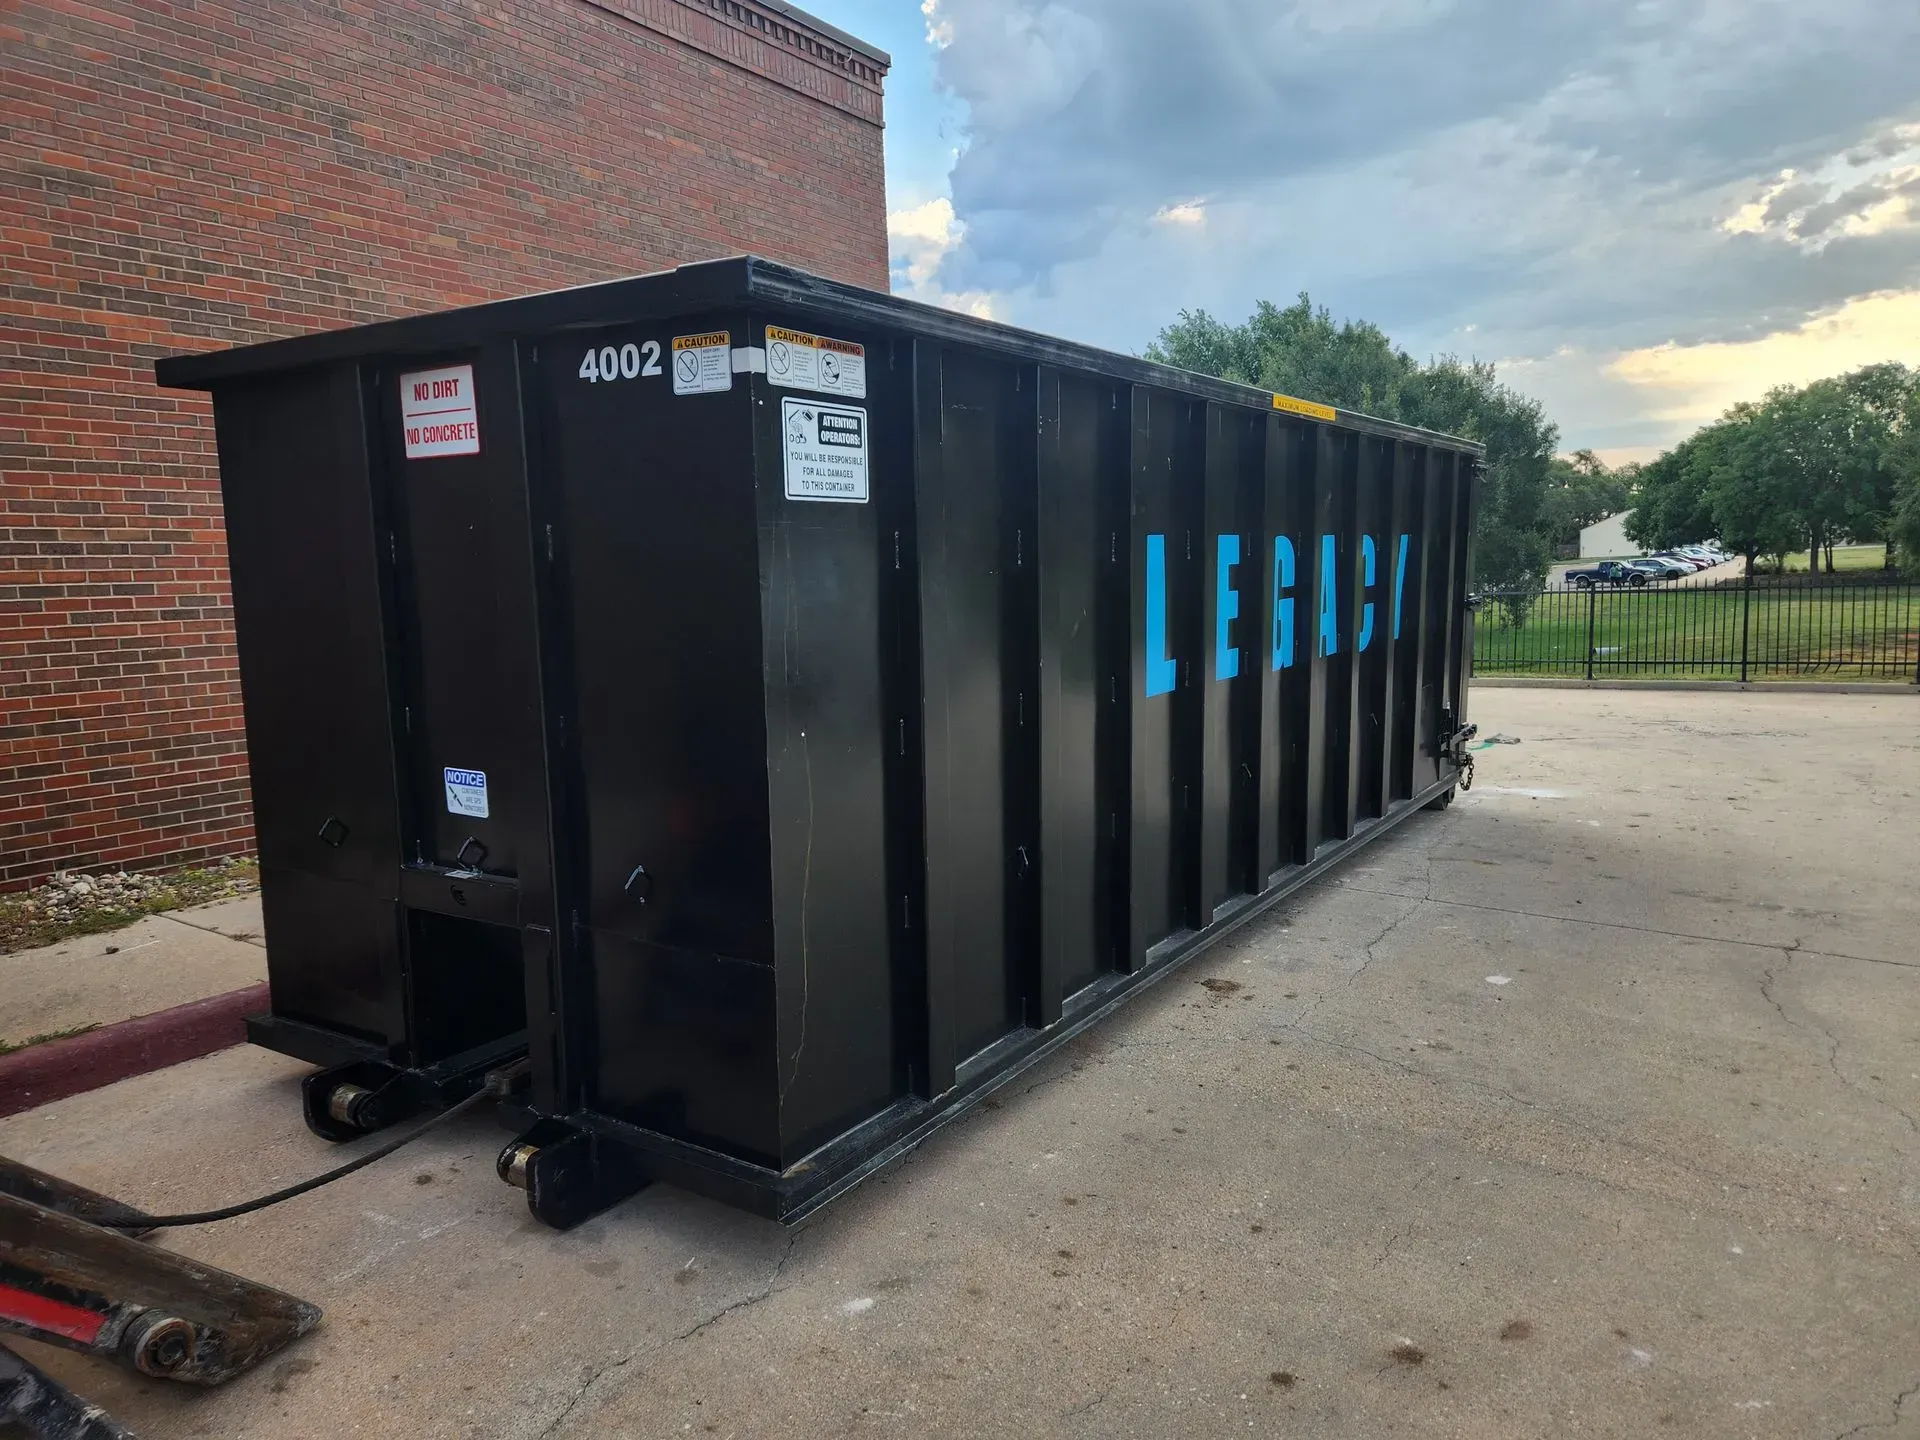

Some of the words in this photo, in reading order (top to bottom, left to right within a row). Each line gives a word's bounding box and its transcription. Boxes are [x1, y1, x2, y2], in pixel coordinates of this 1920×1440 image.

[684, 335, 725, 347] CAUTION
[777, 330, 813, 346] CAUTION
[825, 341, 860, 355] WARNING
[579, 340, 662, 383] 4002
[414, 383, 429, 401] NO
[433, 379, 459, 399] DIRT
[823, 415, 858, 430] ATTENTION
[406, 428, 420, 445] NO
[423, 422, 476, 443] CONCRETE
[820, 430, 860, 446] OPERATORS:
[790, 452, 803, 460] YOU
[804, 453, 817, 461] WILL
[819, 454, 826, 462] BE
[827, 454, 863, 466] RESPONSIBLE
[803, 466, 814, 476] FOR
[815, 467, 826, 477] ALL
[827, 468, 853, 478] DAMAGES
[802, 480, 809, 490] TO
[811, 481, 824, 491] THIS
[824, 482, 854, 492] CONTAINER
[447, 770, 483, 786] NOTICE
